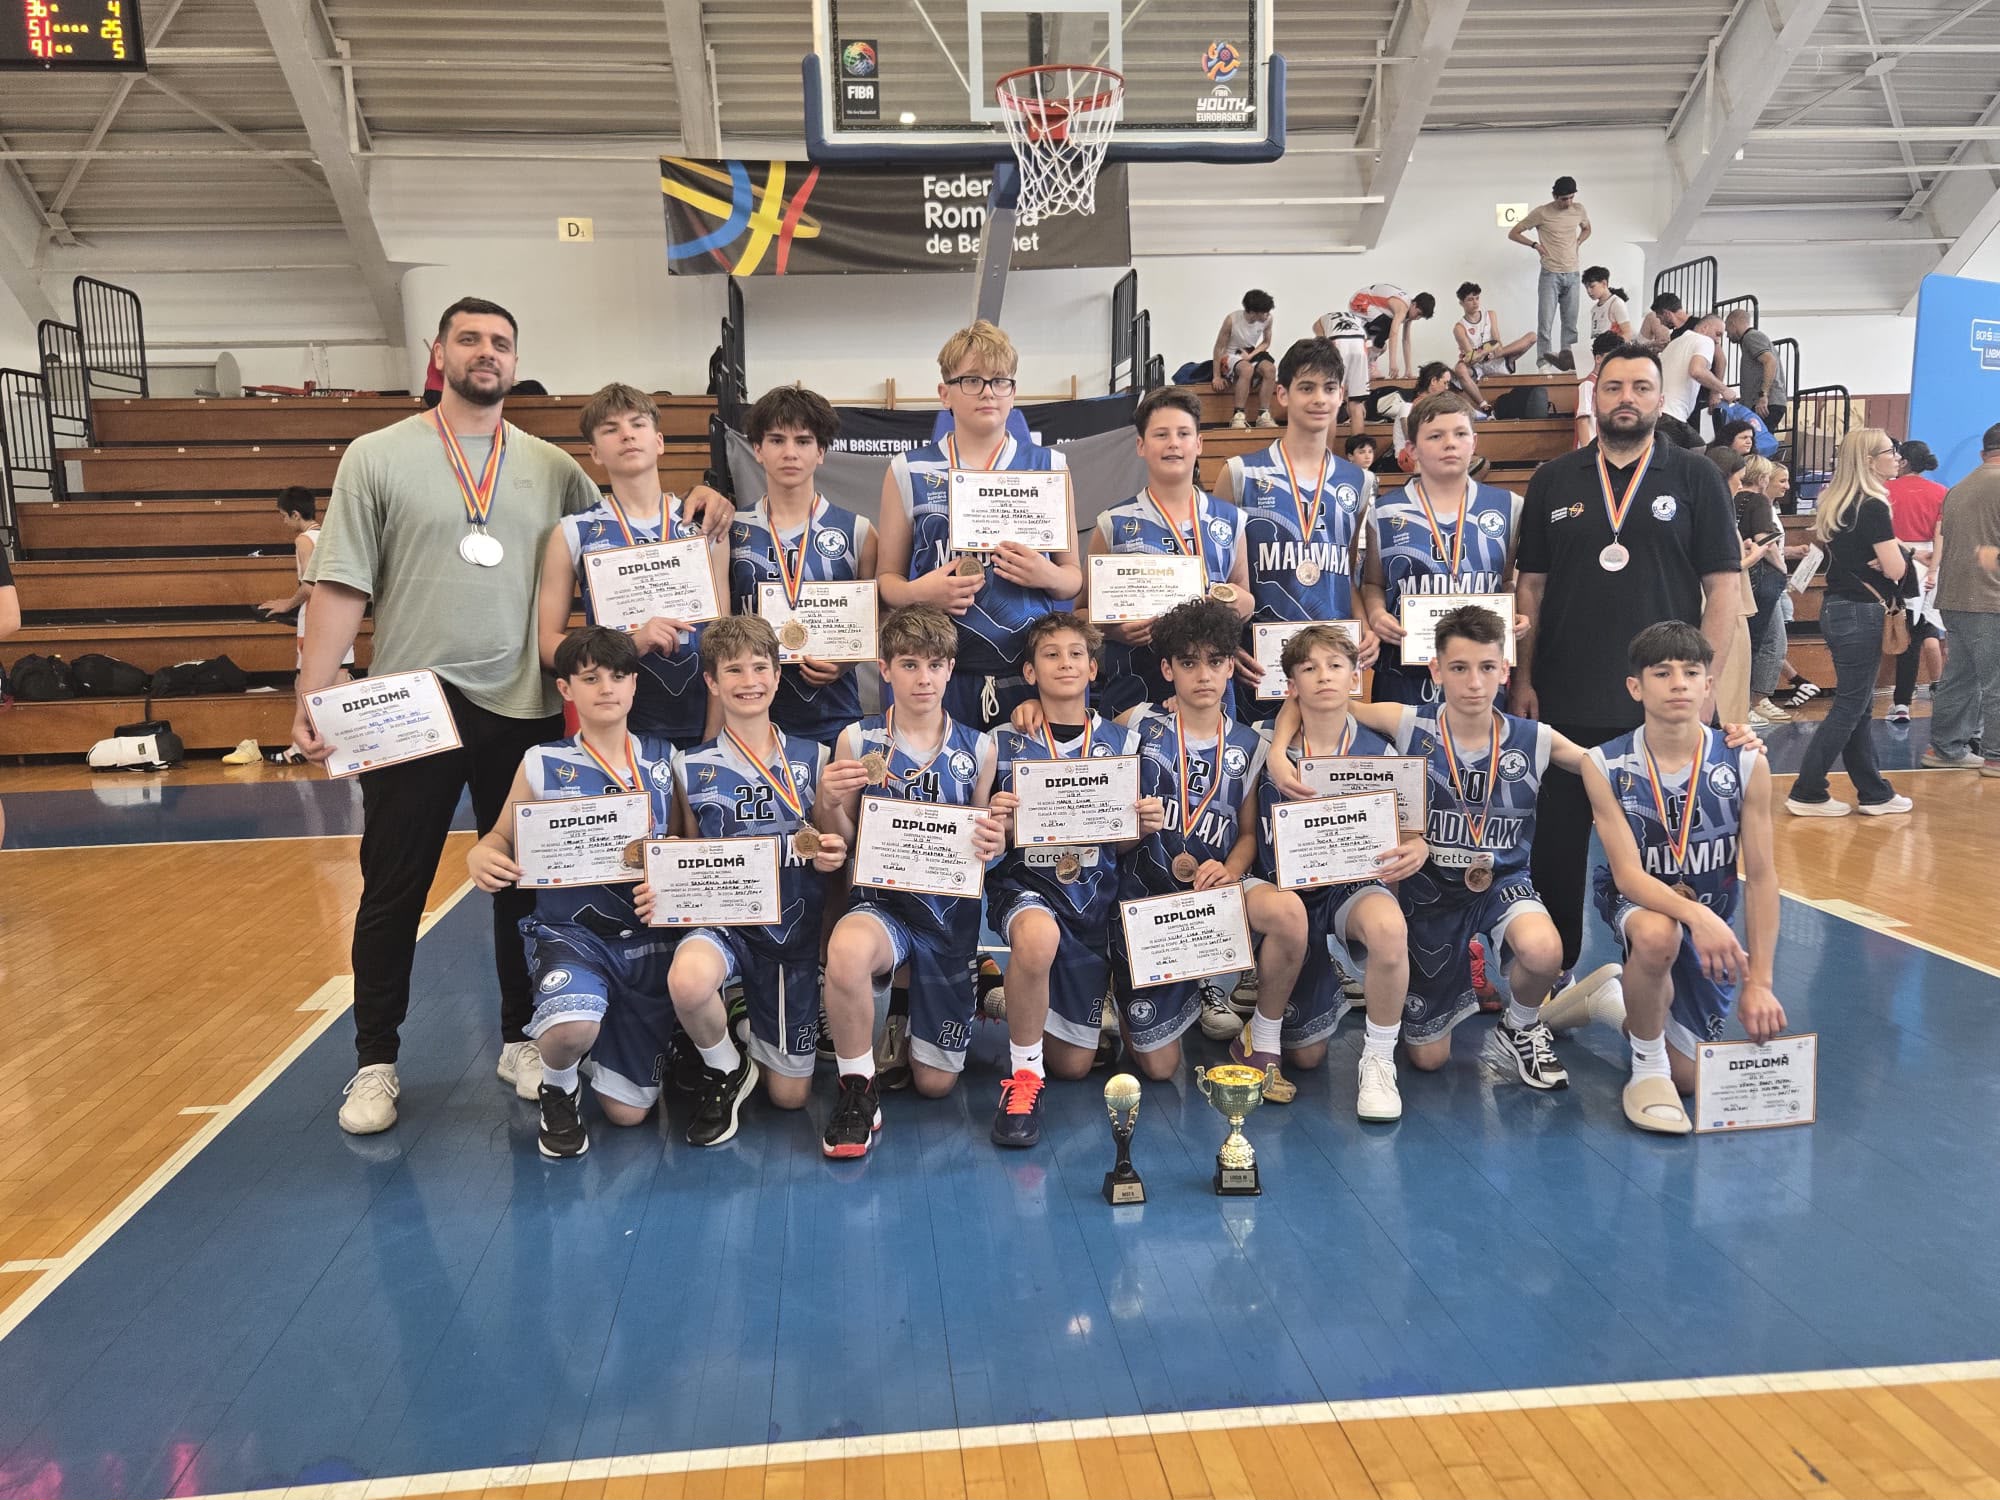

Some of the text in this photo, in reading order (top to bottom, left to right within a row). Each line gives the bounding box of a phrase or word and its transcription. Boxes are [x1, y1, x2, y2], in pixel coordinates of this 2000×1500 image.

[28, 19, 122, 38] 51 25
[31, 39, 125, 58] 91 5
[847, 85, 874, 99] FIBA
[1196, 98, 1247, 111] YOUTH
[1196, 112, 1248, 122] EUROBASKET
[926, 233, 952, 253] de
[850, 440, 918, 453] BASKETBALL
[979, 486, 1039, 497] DIPLOMĂ
[618, 556, 681, 576] DIPLOMĂ
[797, 596, 848, 608] IPLOMĂ
[342, 687, 411, 713] DIPLOMĂ
[1045, 774, 1109, 788] DIPLOMĂ
[1330, 771, 1394, 782] DIPLOMĂ
[735, 785, 775, 821] 22
[550, 811, 618, 829] DIPLOMĂ
[892, 818, 957, 835] DIPLOMĂ
[1304, 810, 1367, 829] DIPLOMĂ
[678, 855, 745, 869] DIPLOMĂ
[1154, 904, 1216, 925] DIPLOMĂ
[1729, 1054, 1789, 1071] DIPLOMĂ
